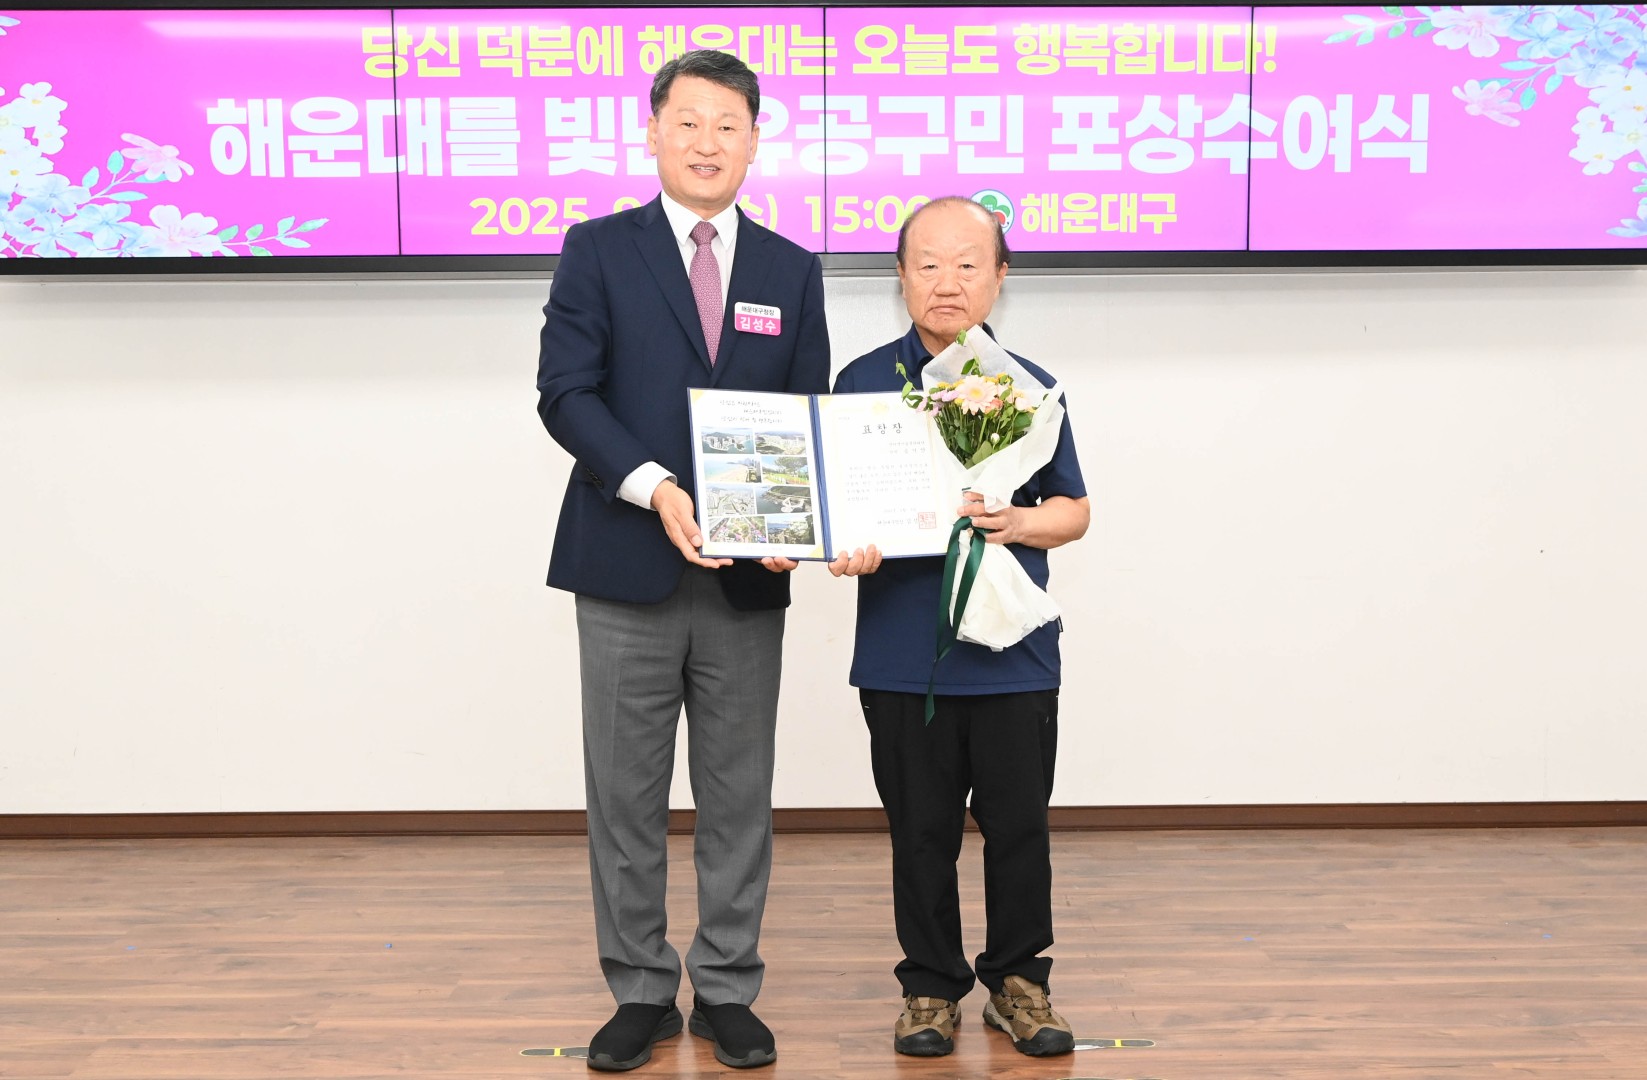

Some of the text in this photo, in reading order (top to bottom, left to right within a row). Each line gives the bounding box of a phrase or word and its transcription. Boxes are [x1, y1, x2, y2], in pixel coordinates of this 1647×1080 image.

[362, 26, 460, 78] 당신
[479, 26, 624, 77] 덕분에
[853, 25, 999, 75] 오늘도
[1015, 24, 1277, 75] 행복합니다!
[207, 97, 520, 177] 해운대를
[1049, 94, 1430, 175] 포상수여식
[1021, 193, 1177, 234] 해운대구
[740, 316, 776, 333] 김성수
